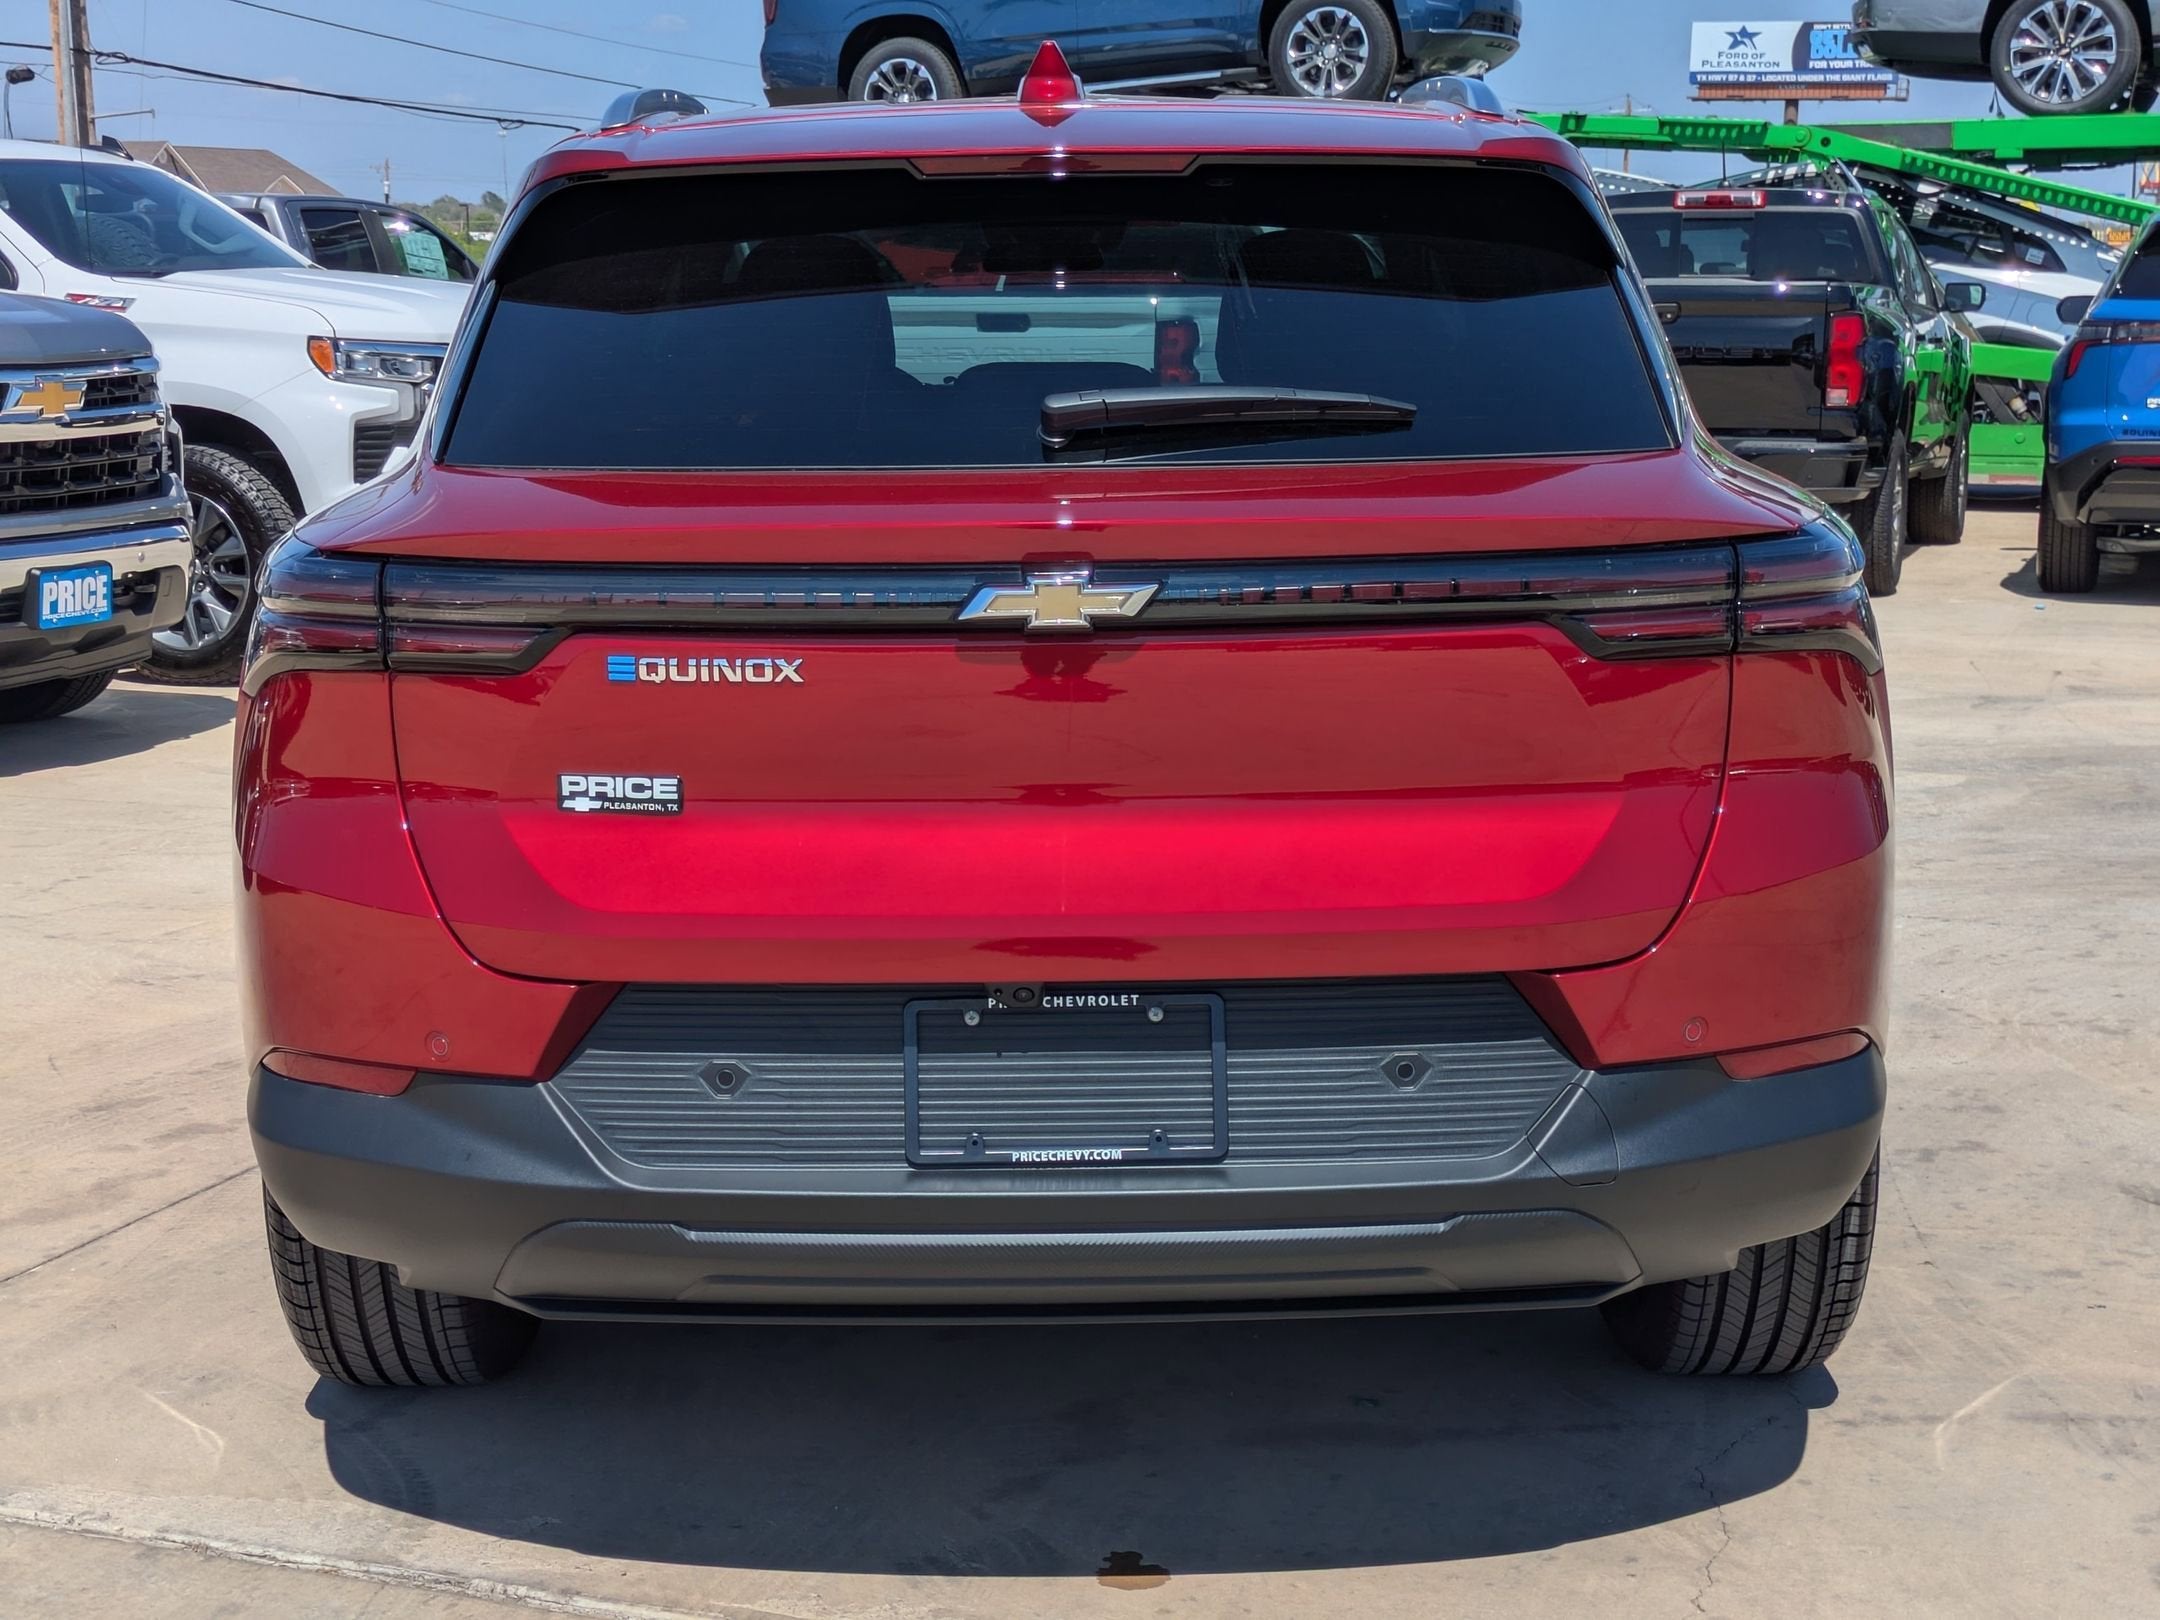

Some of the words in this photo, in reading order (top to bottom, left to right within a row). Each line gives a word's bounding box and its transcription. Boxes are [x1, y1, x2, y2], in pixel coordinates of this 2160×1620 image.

[1718, 51, 1749, 60] FORD
[1702, 60, 1780, 68] PLEASANTON
[1809, 61, 1827, 69] FOR
[1829, 61, 1853, 69] YOUR
[1855, 61, 1874, 69] TRA
[1762, 74, 1796, 82] LOCATED
[1798, 74, 1824, 82] UNDER
[43, 575, 107, 615] PRICE
[607, 655, 805, 683] EQUINOX
[561, 776, 679, 799] PRICE
[604, 802, 665, 812] PLEASANTON,
[1043, 994, 1140, 1008] CHEVROLET
[1012, 1149, 1122, 1162] PRICECHEVY.COM
